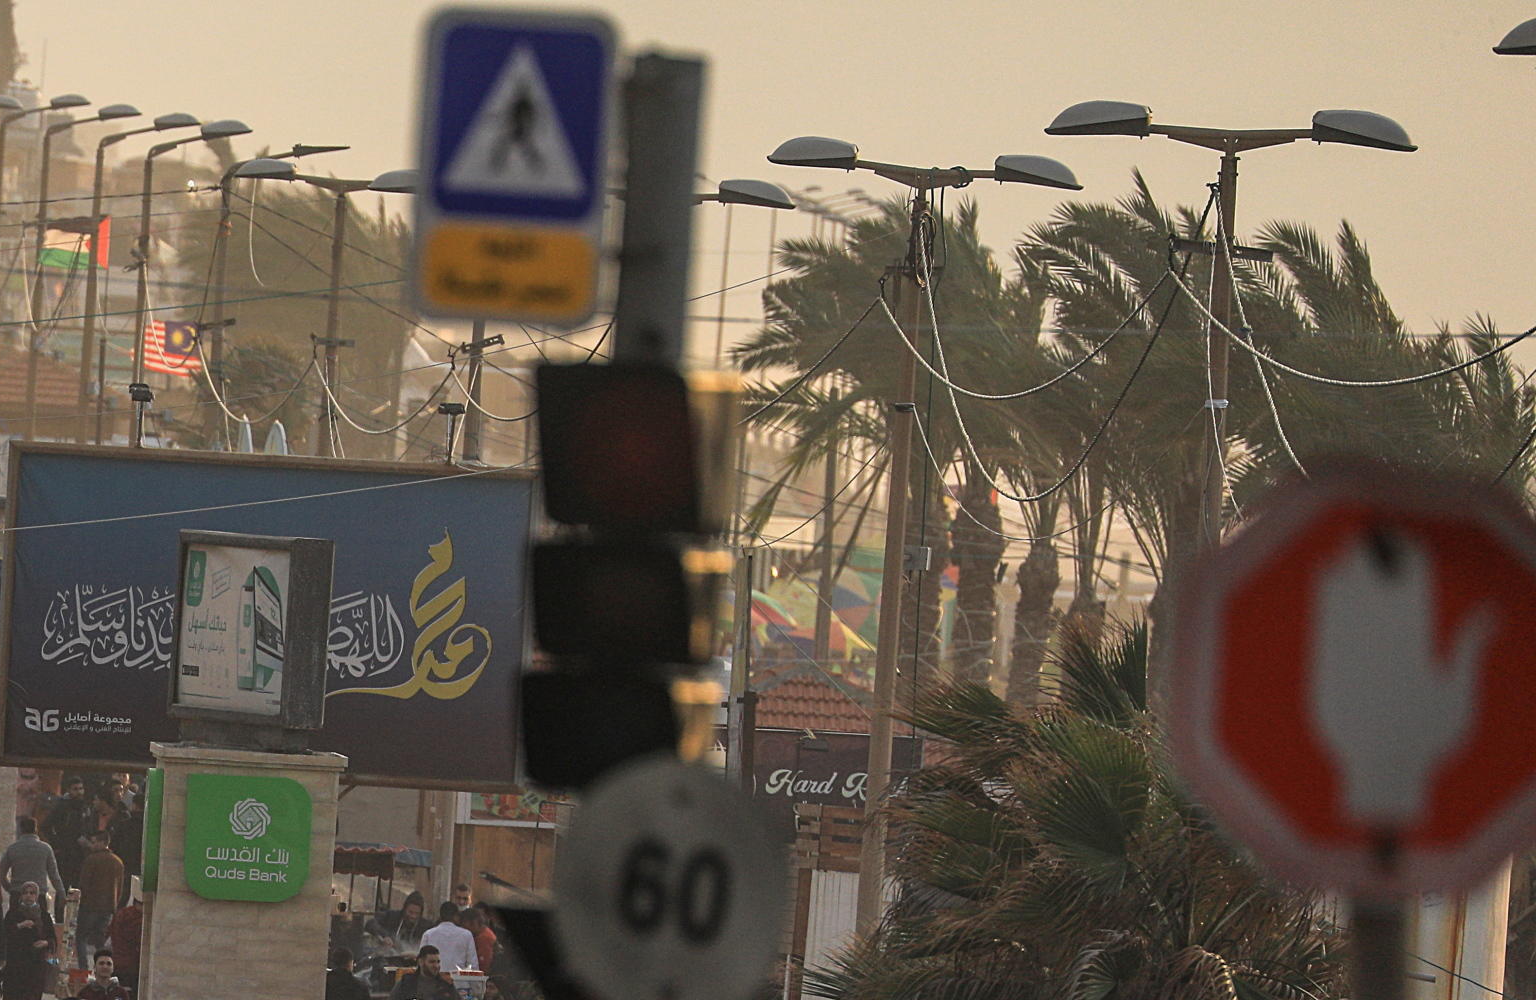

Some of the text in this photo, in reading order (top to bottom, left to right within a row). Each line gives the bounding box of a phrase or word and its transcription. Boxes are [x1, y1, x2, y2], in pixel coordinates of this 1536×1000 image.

[64, 710, 132, 726] مجموعة أصايل
[765, 768, 838, 797] Hard
[206, 847, 290, 868] بنك القدس
[205, 866, 288, 884] Quds Bank
[622, 836, 732, 944] 60
